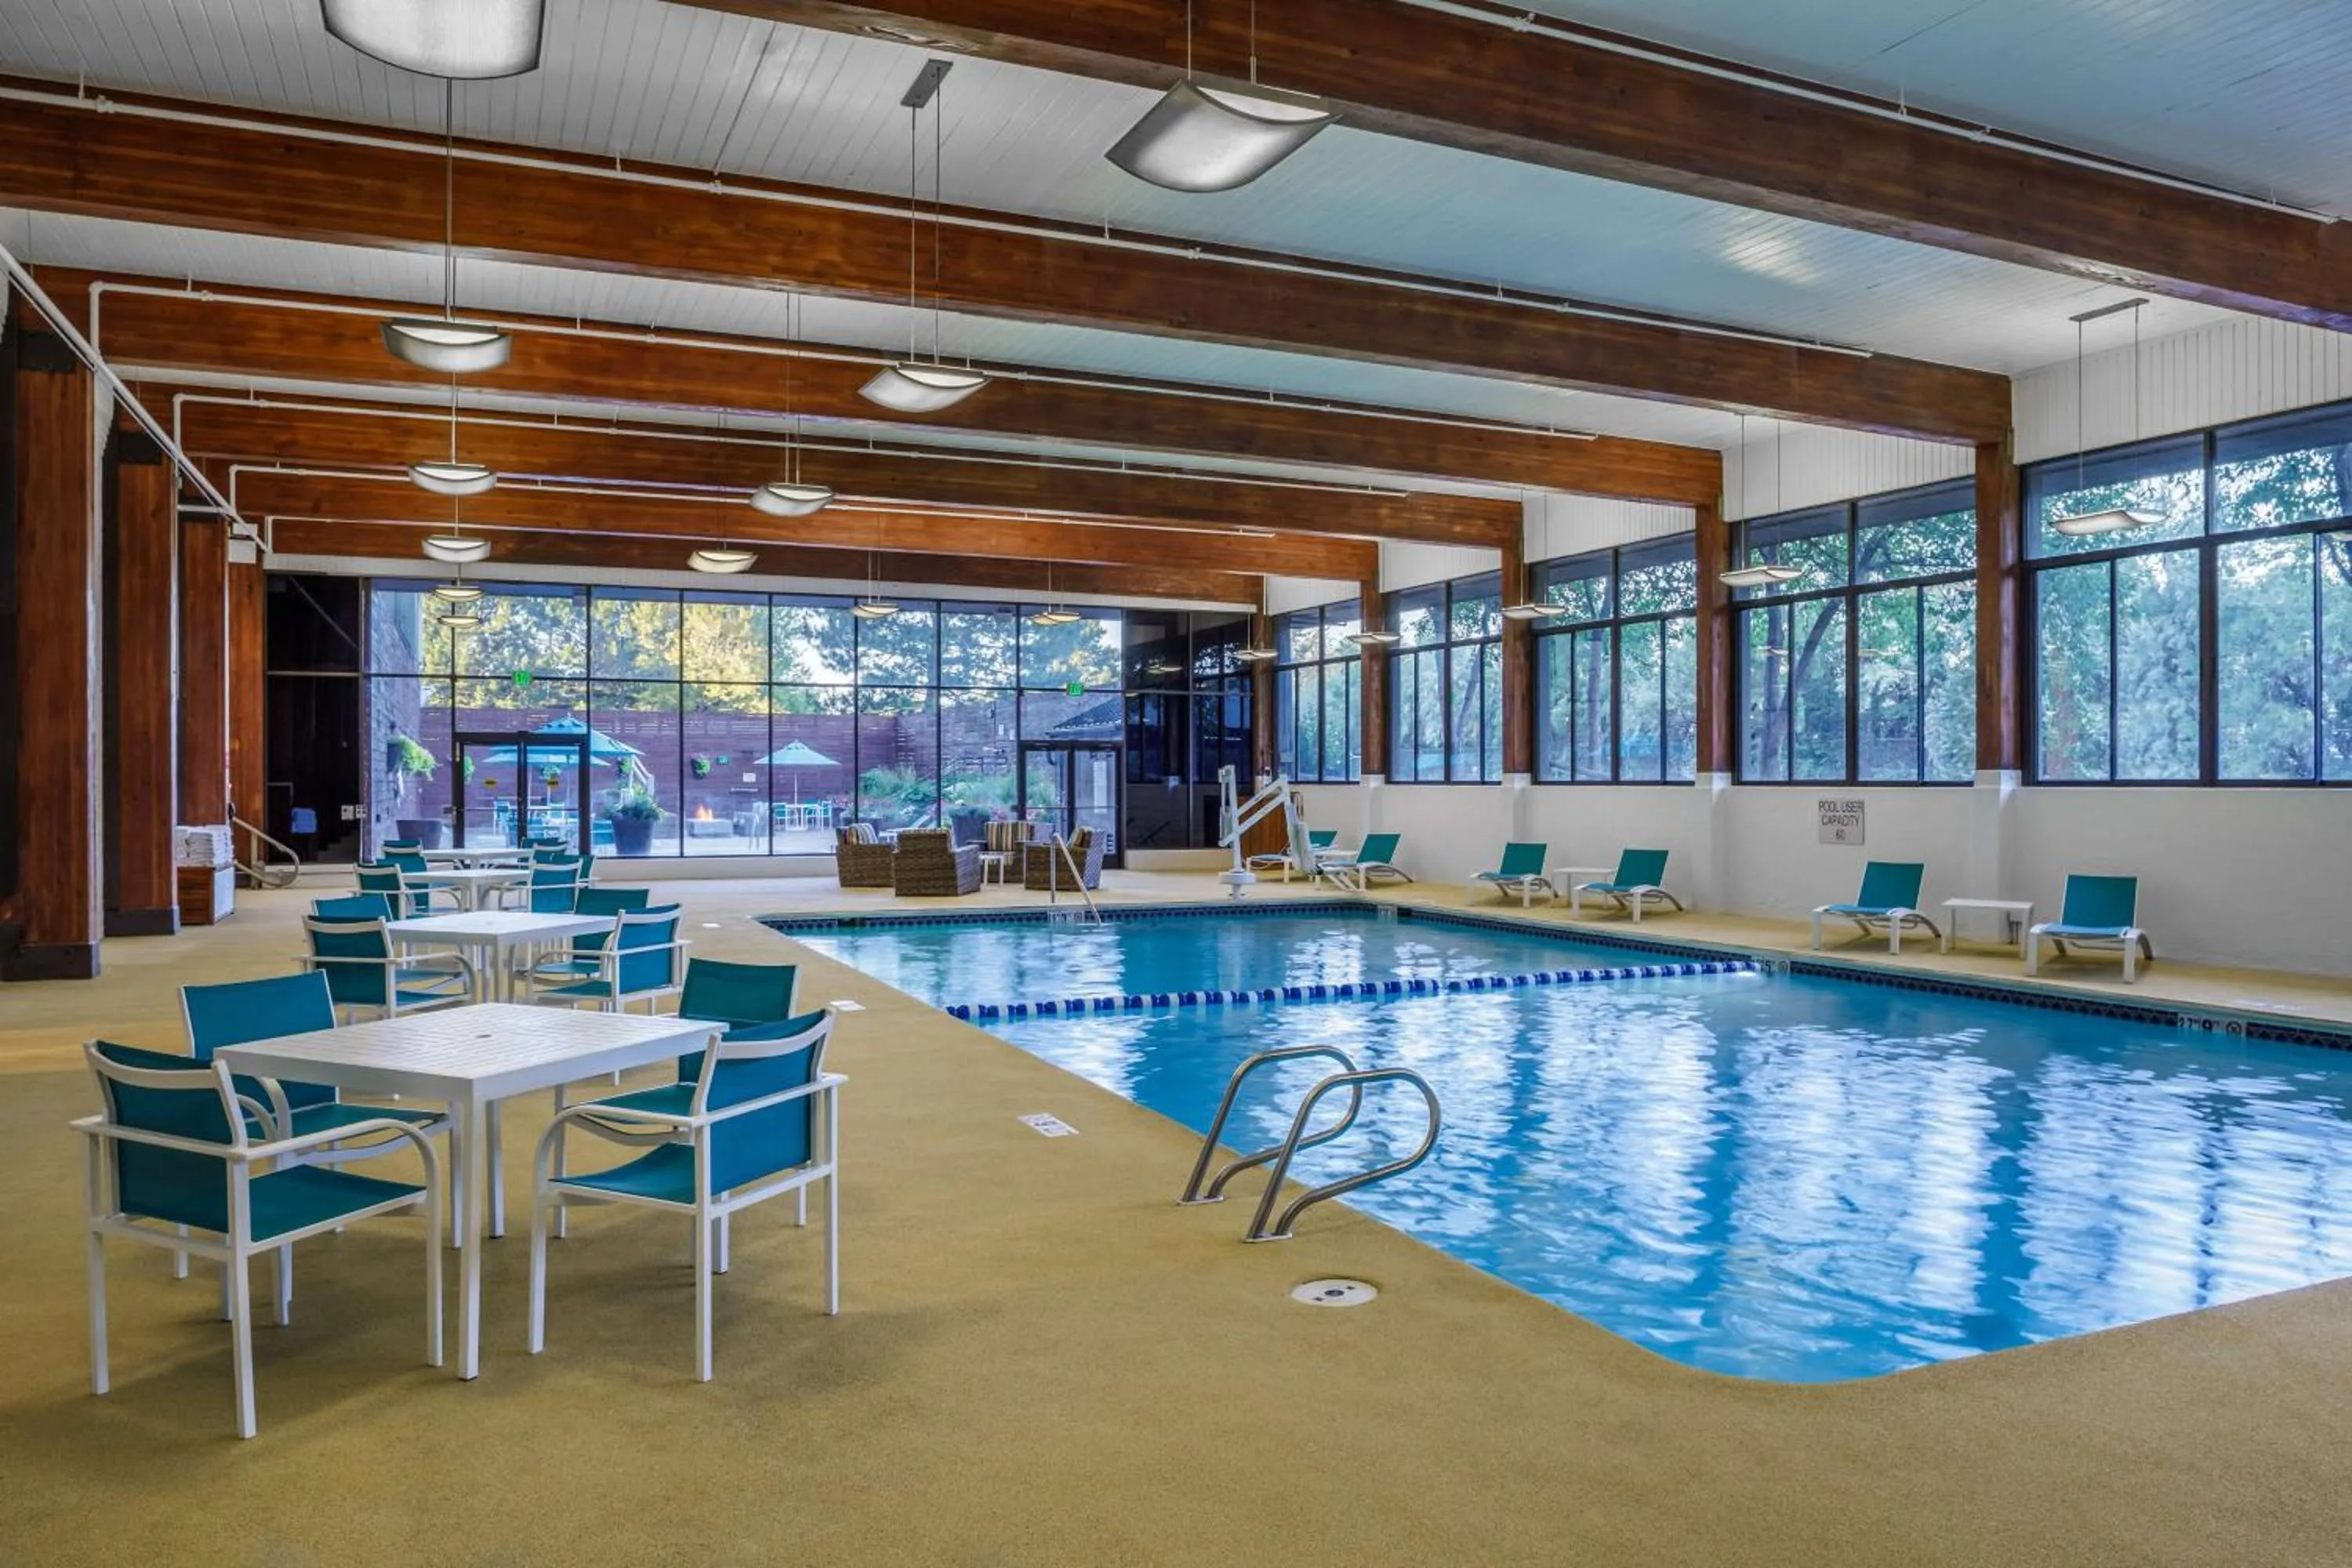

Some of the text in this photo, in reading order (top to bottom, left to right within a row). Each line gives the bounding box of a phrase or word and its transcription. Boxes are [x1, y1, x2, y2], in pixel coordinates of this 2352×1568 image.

[1819, 800, 1864, 814] POOL USER
[1821, 814, 1860, 826] CAPACITY
